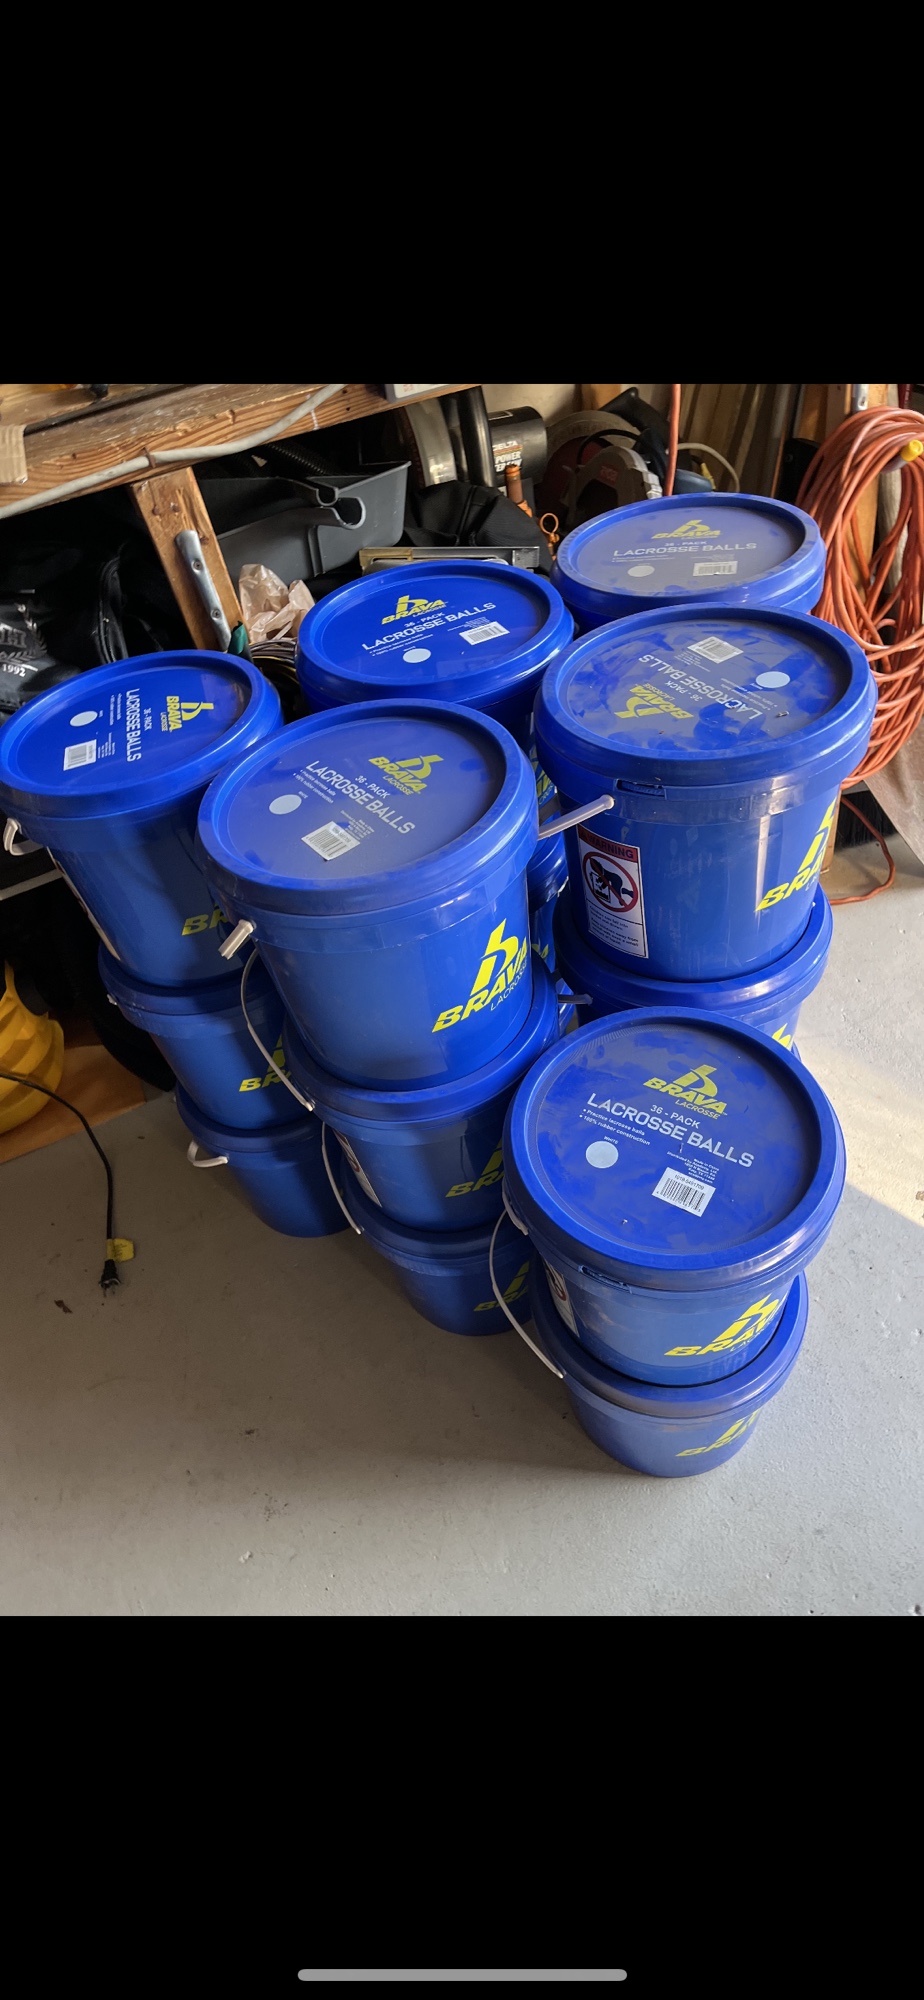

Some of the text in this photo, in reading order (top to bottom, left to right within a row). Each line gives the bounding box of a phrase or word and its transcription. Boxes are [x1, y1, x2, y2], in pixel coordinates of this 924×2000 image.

[495, 452, 522, 464] POWER
[651, 530, 721, 539] BRAVA
[613, 543, 757, 557] LACROSSE BALLS
[382, 600, 445, 625] BRAVA
[421, 612, 446, 623] PACK
[362, 618, 446, 651] LACROSSE
[445, 603, 497, 622] BALLS
[3, 664, 26, 677] 1992
[639, 654, 687, 680] BALLS
[665, 681, 688, 694] PACK
[684, 676, 763, 720] LACROSSE
[166, 696, 183, 732] BRAVA
[630, 686, 695, 719] BRAVA
[126, 688, 142, 762] LACROSSE BALLS
[144, 717, 152, 731] PACK
[355, 776, 365, 784] 36
[367, 784, 391, 799] PACK
[368, 757, 428, 793] BRAVA
[383, 776, 414, 796] LACROSSE
[306, 761, 374, 805] LACROSSE
[366, 800, 416, 834] BALLS
[432, 936, 528, 1033] BRAVA
[643, 1078, 728, 1115] BRAVA
[651, 1105, 663, 1114] 36
[670, 1112, 701, 1129] PACK
[675, 1100, 720, 1120] LACROSSE
[584, 1116, 651, 1146] 100% rubber construction
[587, 1110, 645, 1136] Practice lacrosse balls
[587, 1093, 755, 1168] LACROSSE BALLS
[604, 1136, 619, 1145] WHITE
